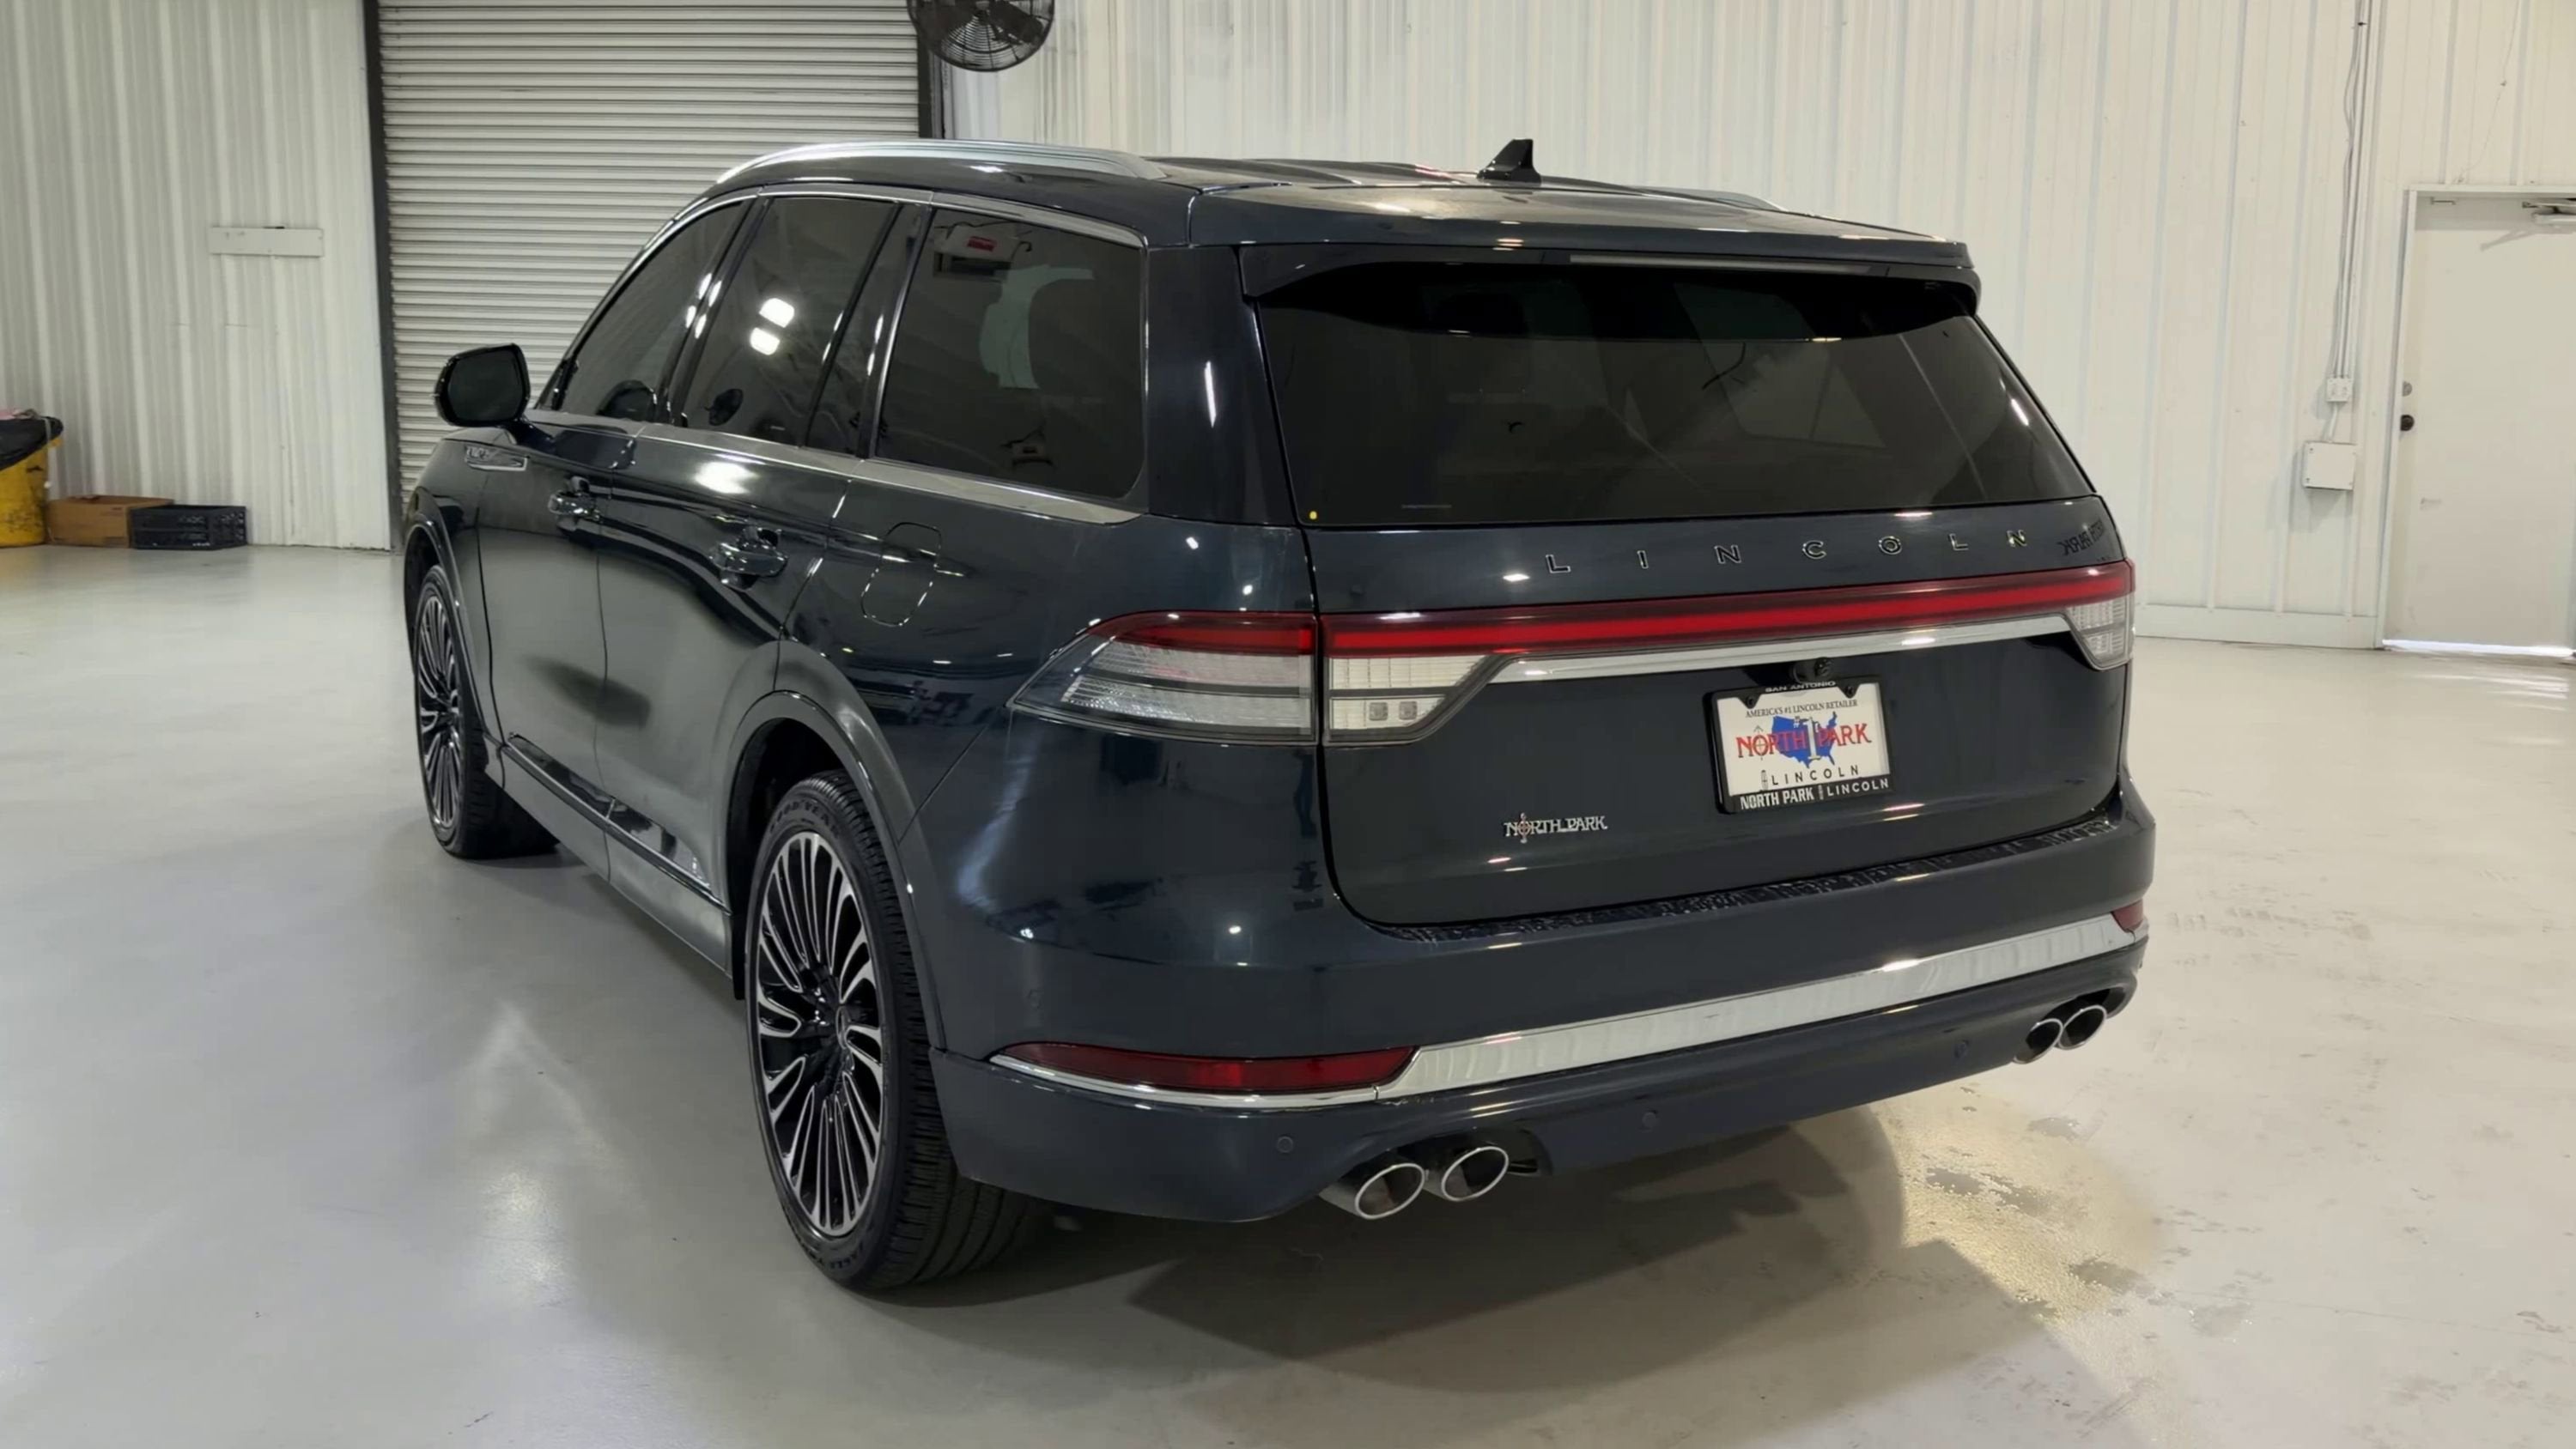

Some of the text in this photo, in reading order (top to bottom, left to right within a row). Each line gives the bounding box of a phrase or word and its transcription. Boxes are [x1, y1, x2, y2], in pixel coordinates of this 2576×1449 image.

[1546, 529, 2027, 574] LINCOLN
[1789, 681, 1836, 690] ANTONIO
[1746, 707, 1783, 718] AMERICA'S
[1792, 702, 1825, 713] LINCOLN
[1826, 700, 1858, 709] RETAILER
[1735, 723, 1872, 759] NORTH PARK
[1771, 765, 1859, 785] LINCOLN
[1741, 779, 1889, 809] NORTH PARK LINCOLN
